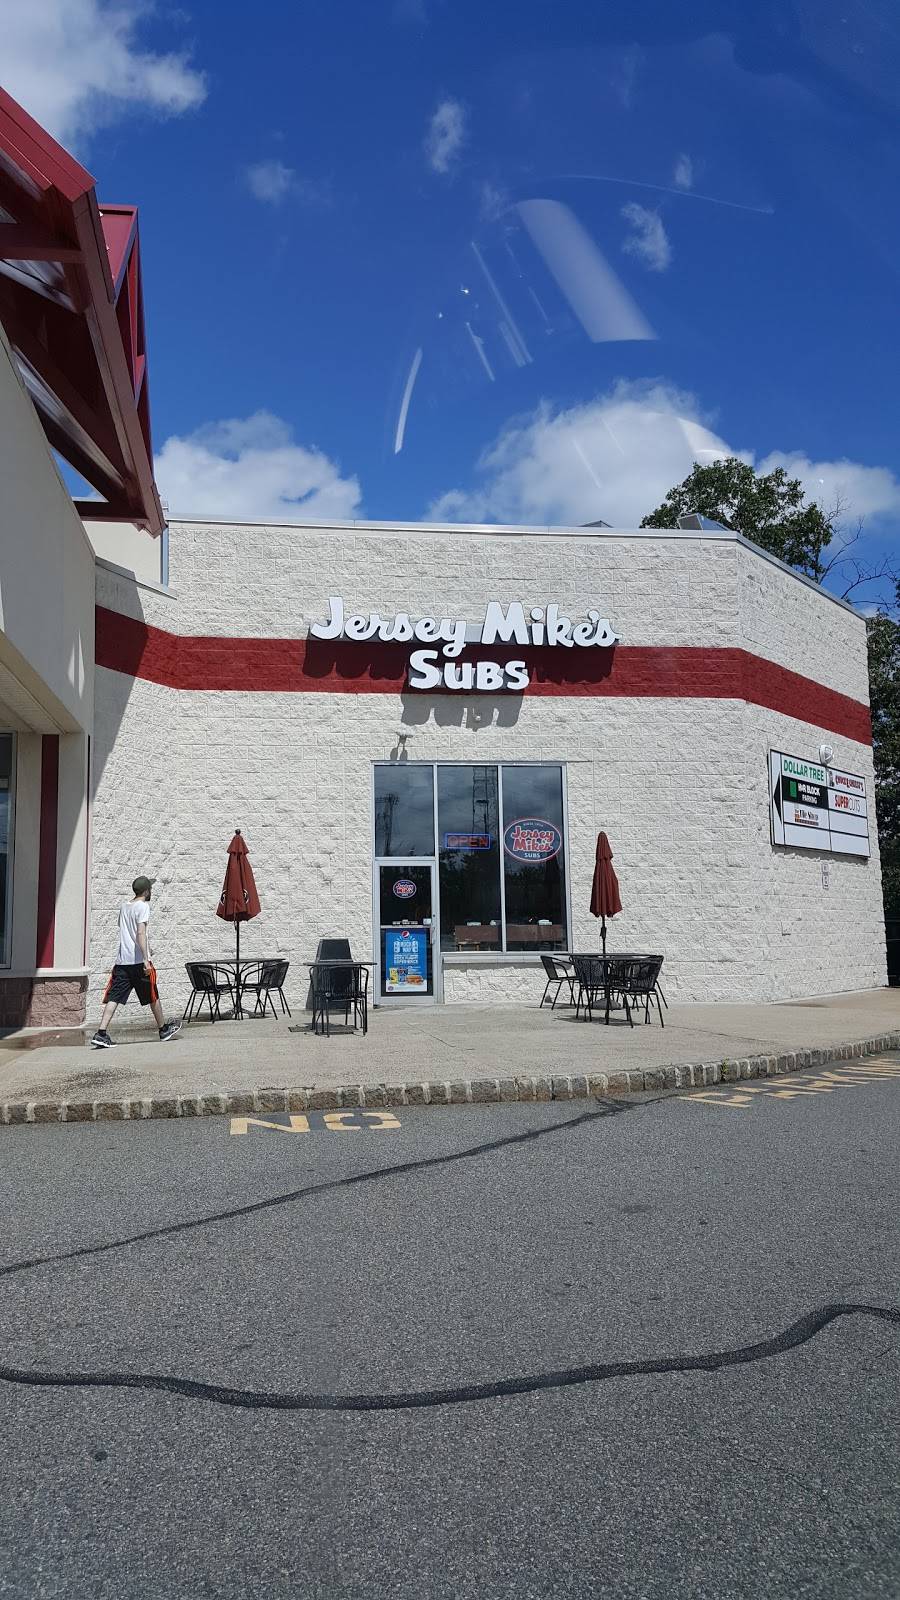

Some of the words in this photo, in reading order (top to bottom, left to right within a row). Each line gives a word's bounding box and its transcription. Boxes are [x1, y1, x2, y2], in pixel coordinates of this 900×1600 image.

[310, 596, 467, 657] Jersey
[481, 600, 623, 647] Mike's
[783, 759, 809, 778] DOLLAR
[809, 767, 825, 782] TREE
[806, 784, 821, 796] BLOCK
[447, 835, 488, 847] OPEN
[511, 825, 554, 842] Jersey
[229, 1112, 402, 1135] NO
